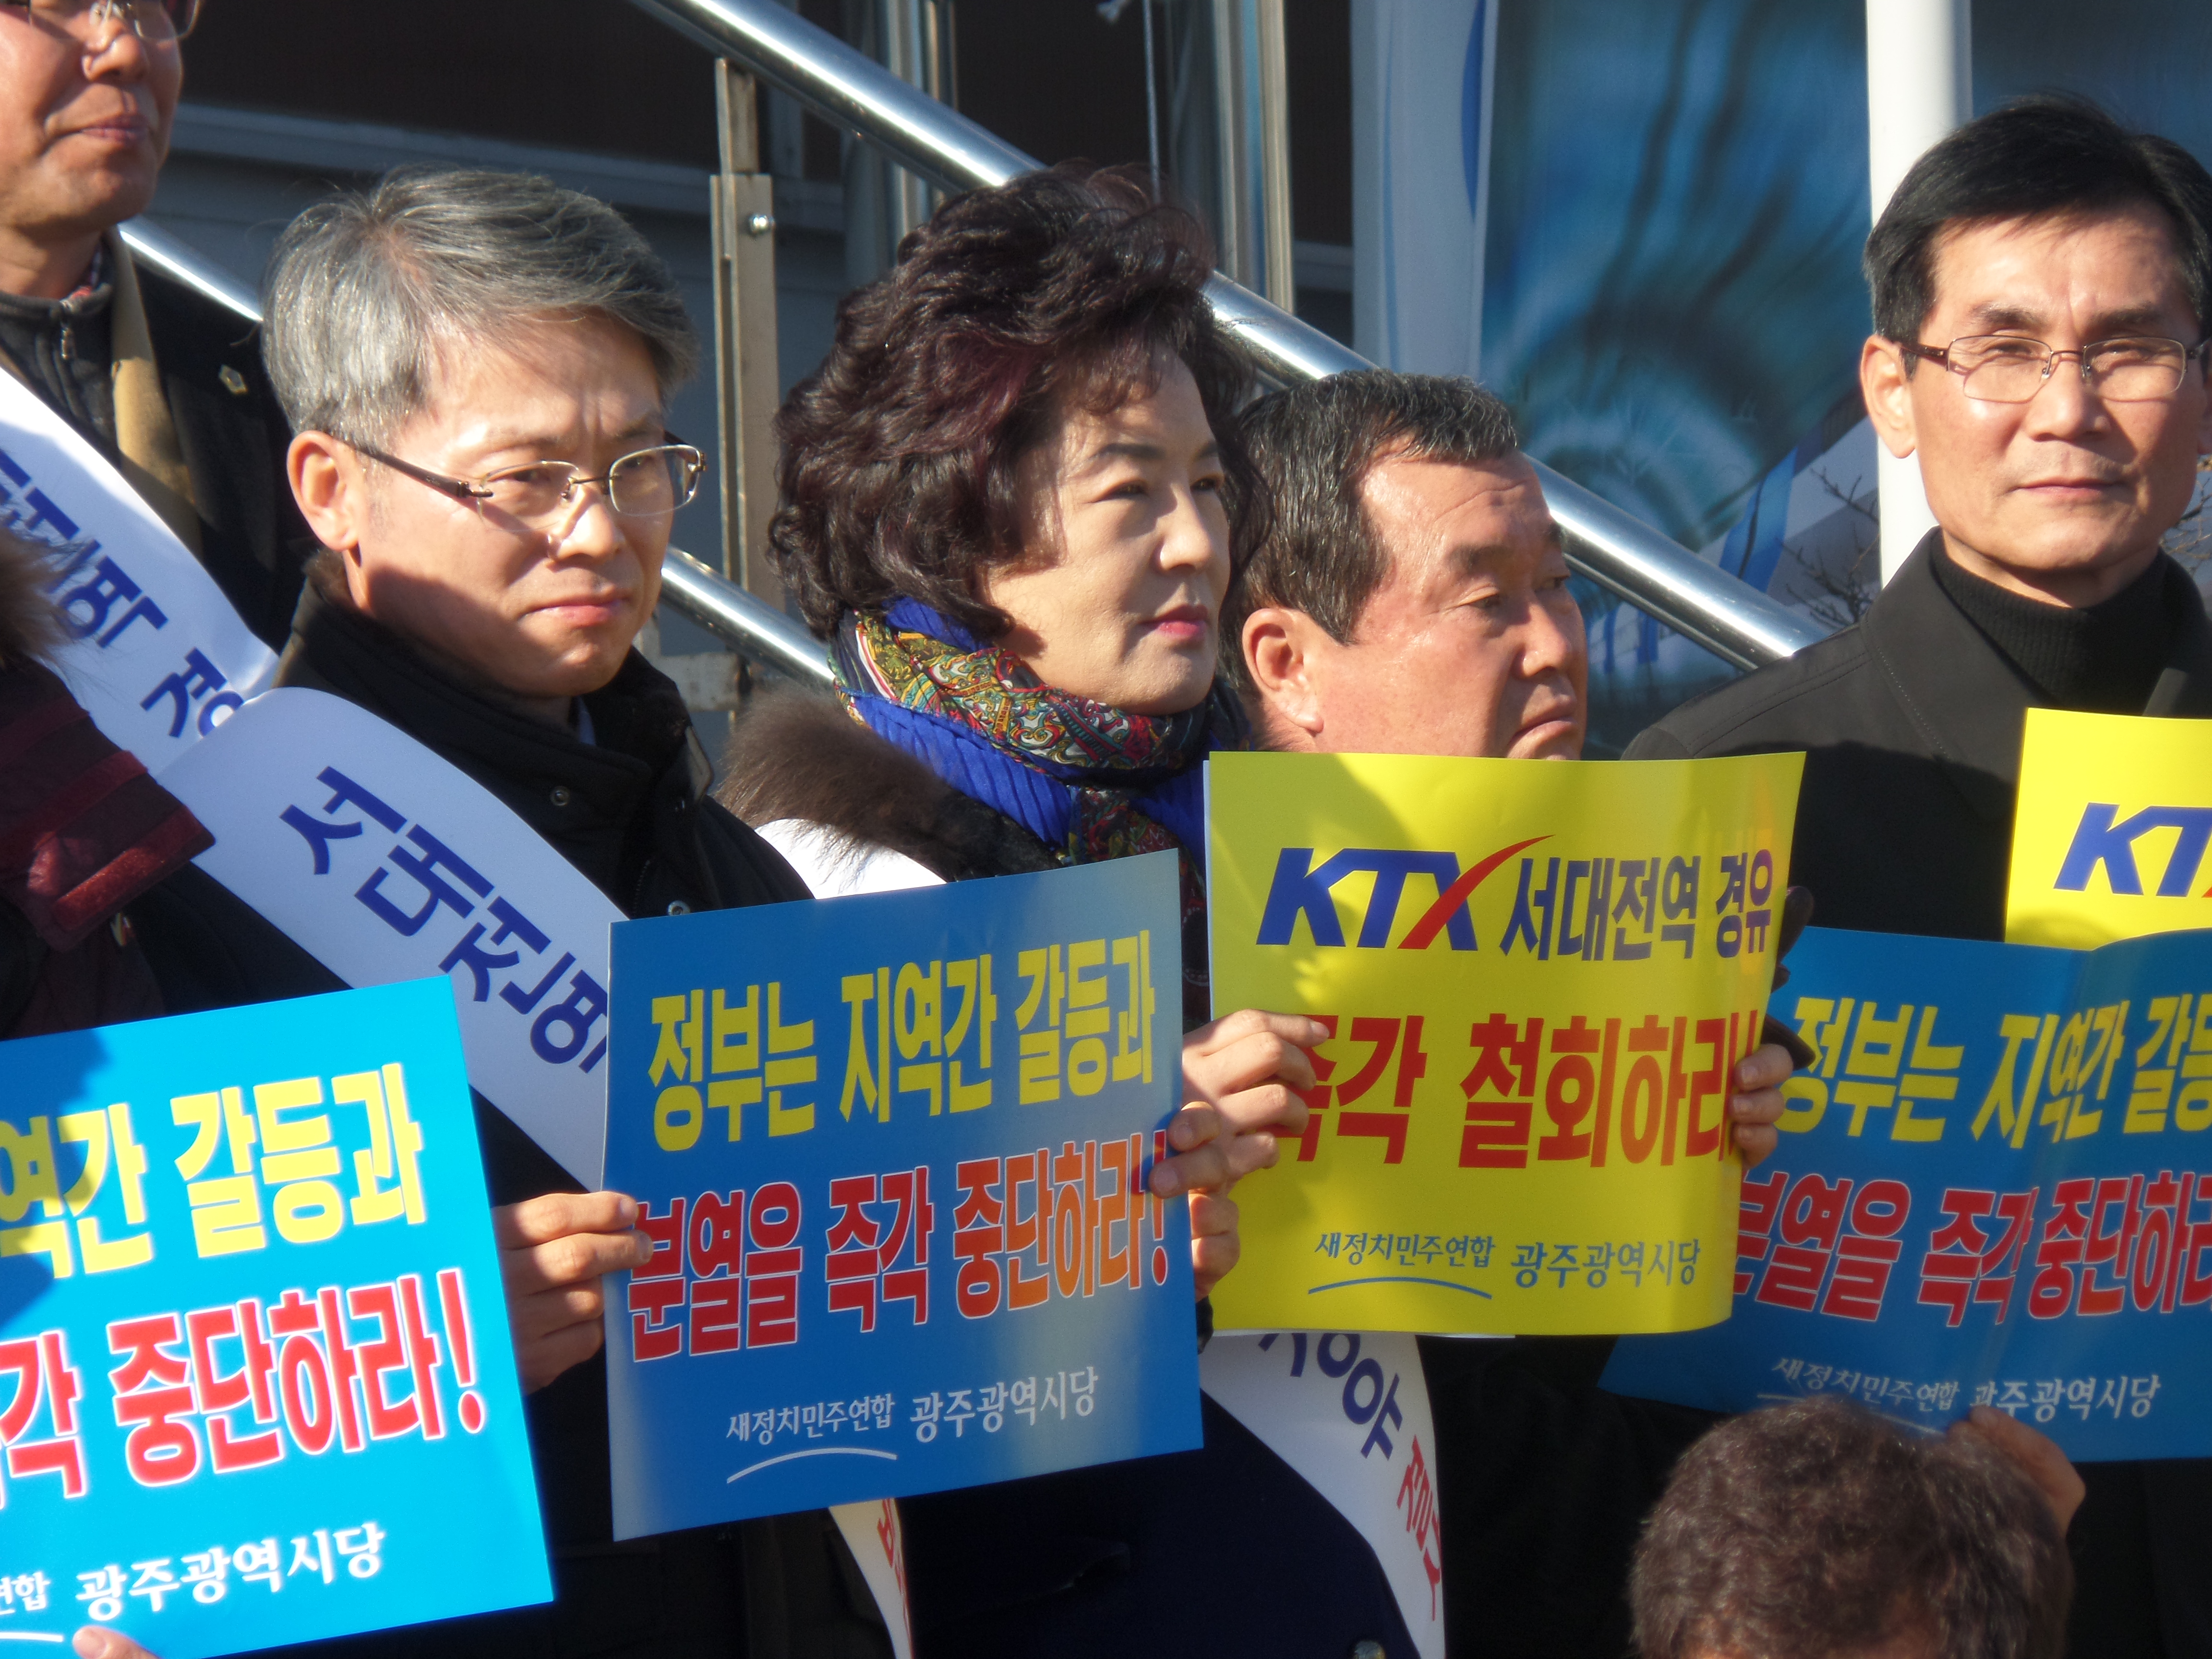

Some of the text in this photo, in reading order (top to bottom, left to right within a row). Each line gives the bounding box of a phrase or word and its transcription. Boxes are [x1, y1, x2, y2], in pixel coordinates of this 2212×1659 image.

[280, 766, 608, 1074] 서대전역
[1255, 834, 1775, 962] KTX 서대전역 경유
[2053, 802, 2212, 898] KT
[648, 928, 1156, 1152] 정부는 지역간 갈등과
[1773, 996, 1966, 1142] 정부는
[1970, 998, 2131, 1149] 지역간
[169, 1062, 425, 1260] 갈등과
[627, 1128, 1168, 1363] 분열을 즉각 중단하라!
[1314, 1231, 1701, 1289] 새정치민주연합 광주광역시당
[1917, 1186, 2040, 1329] 즉각
[0, 1267, 486, 1501] 각 중단하라!
[725, 1366, 1100, 1445] 새정치민주연합 광주광역시당
[1771, 1357, 1961, 1412] 새정치민주연합
[74, 1523, 385, 1621] 광주광역시당
